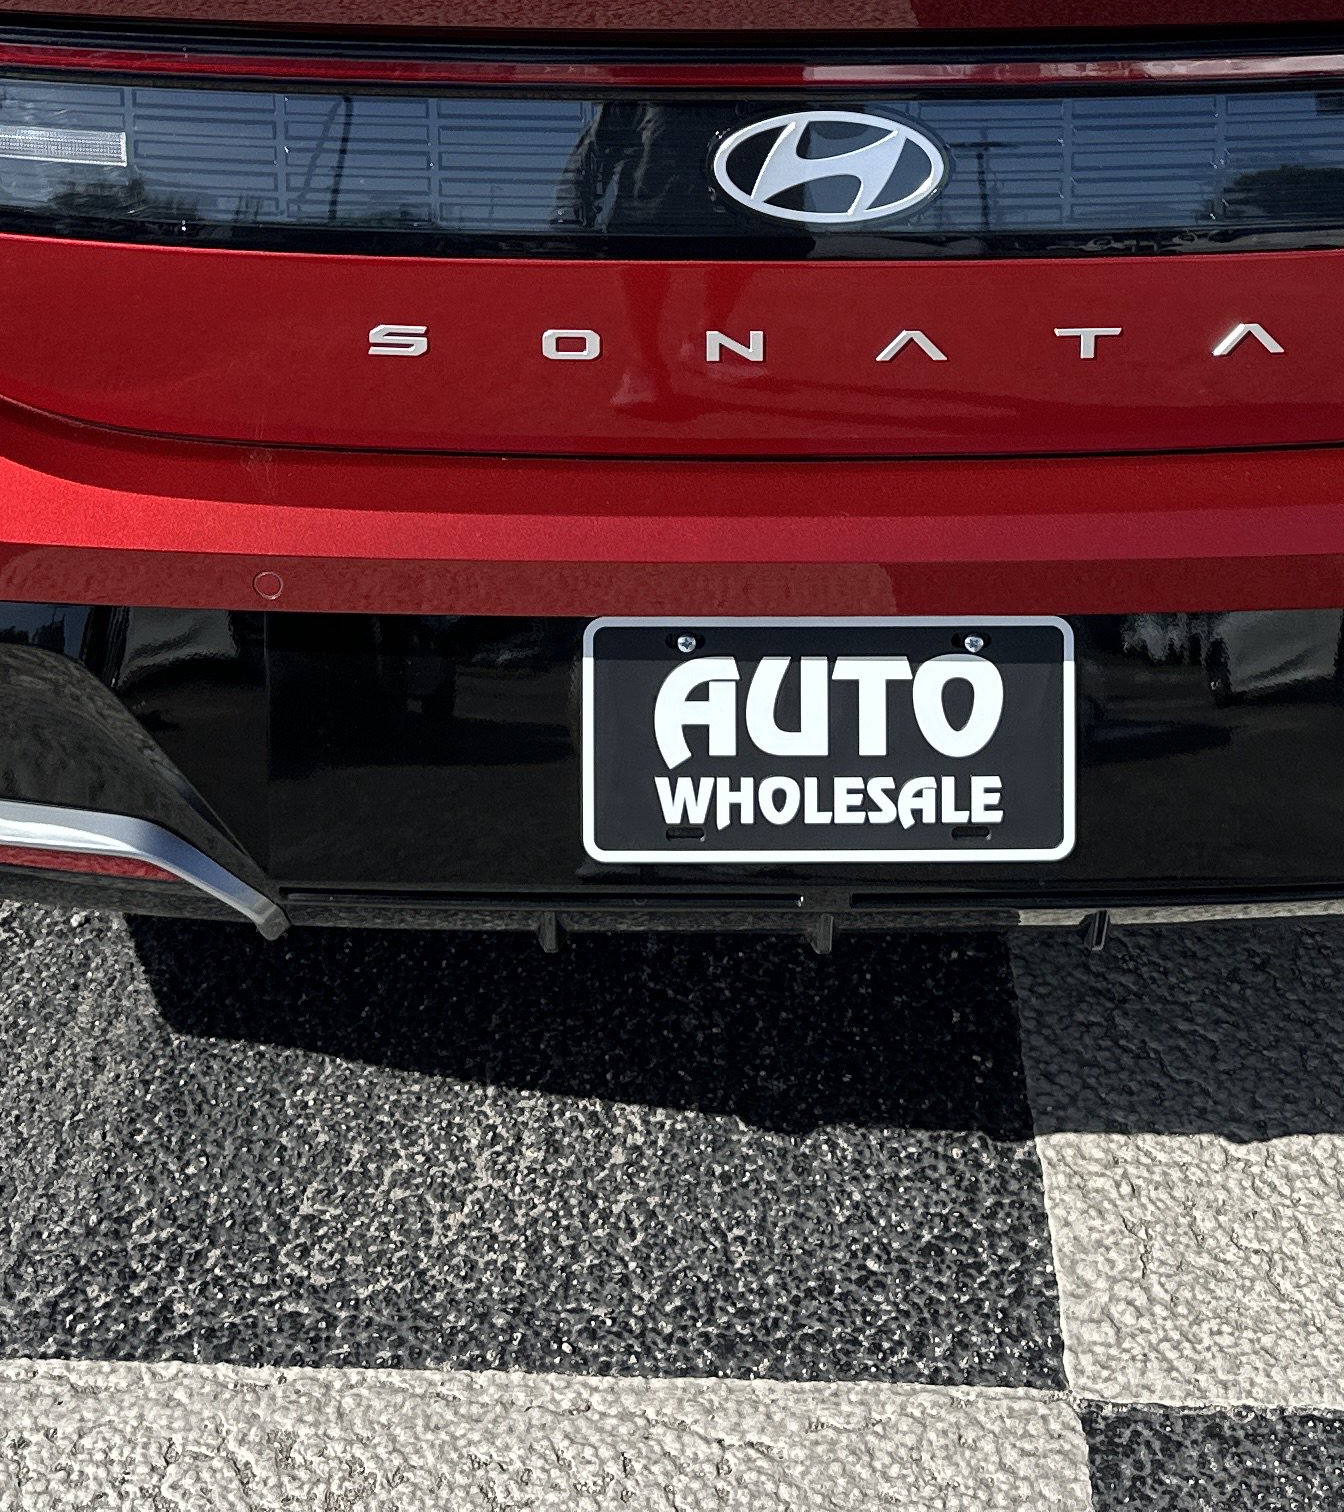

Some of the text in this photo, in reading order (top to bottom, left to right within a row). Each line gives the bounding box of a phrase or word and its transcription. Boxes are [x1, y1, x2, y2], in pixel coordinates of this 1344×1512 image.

[368, 323, 1285, 363] SONATA
[654, 654, 1004, 769] AUTO
[654, 775, 1004, 830] WHOLESALE
